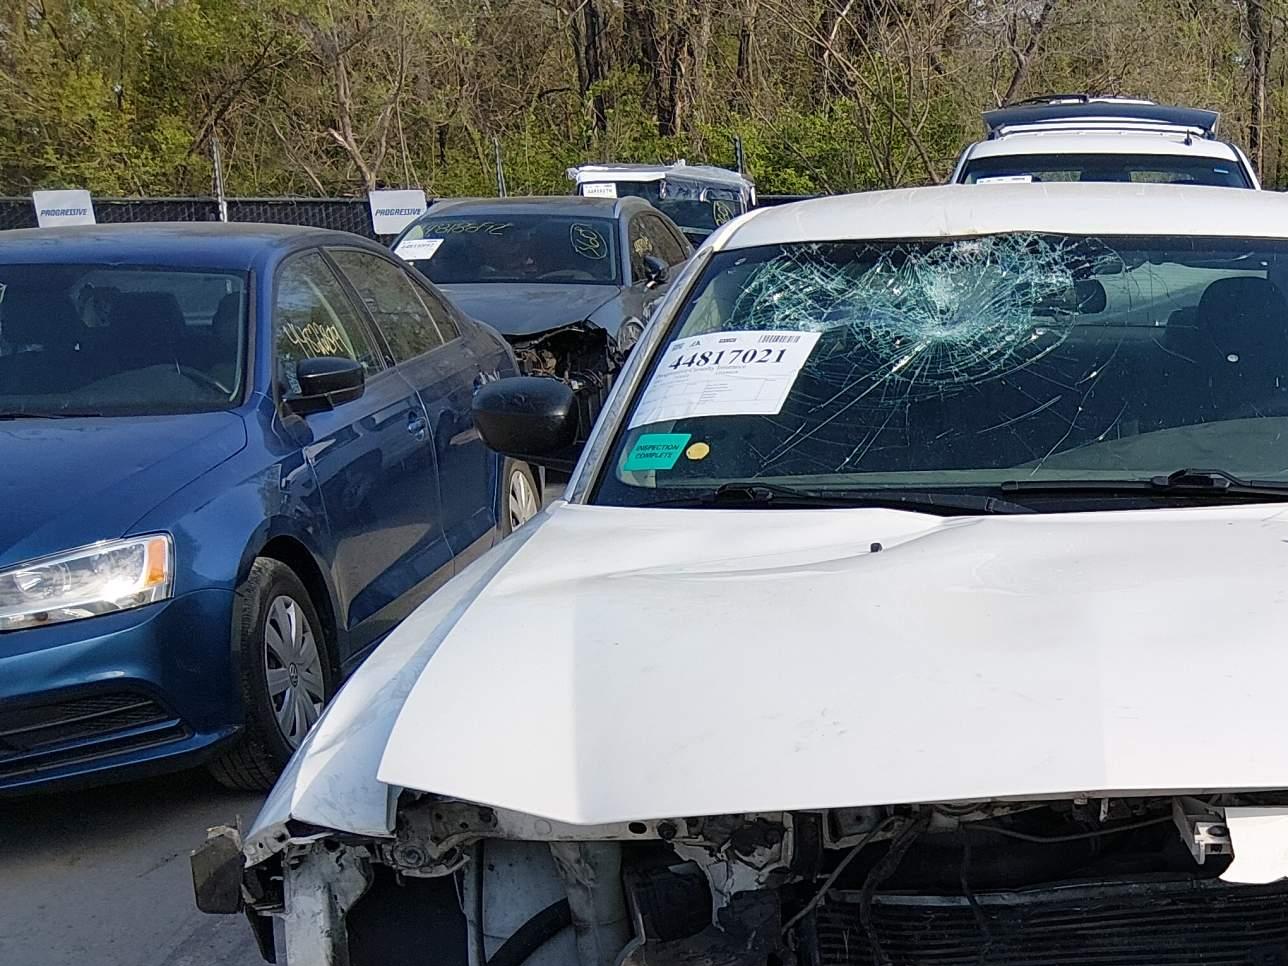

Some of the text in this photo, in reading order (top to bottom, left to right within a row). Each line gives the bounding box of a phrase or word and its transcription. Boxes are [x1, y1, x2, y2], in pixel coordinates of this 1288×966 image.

[40, 208, 88, 216] PROGRESSIVE
[374, 208, 422, 216] PROGRESSIVE
[668, 348, 787, 370] 44817021
[635, 444, 680, 452] INSPECTION
